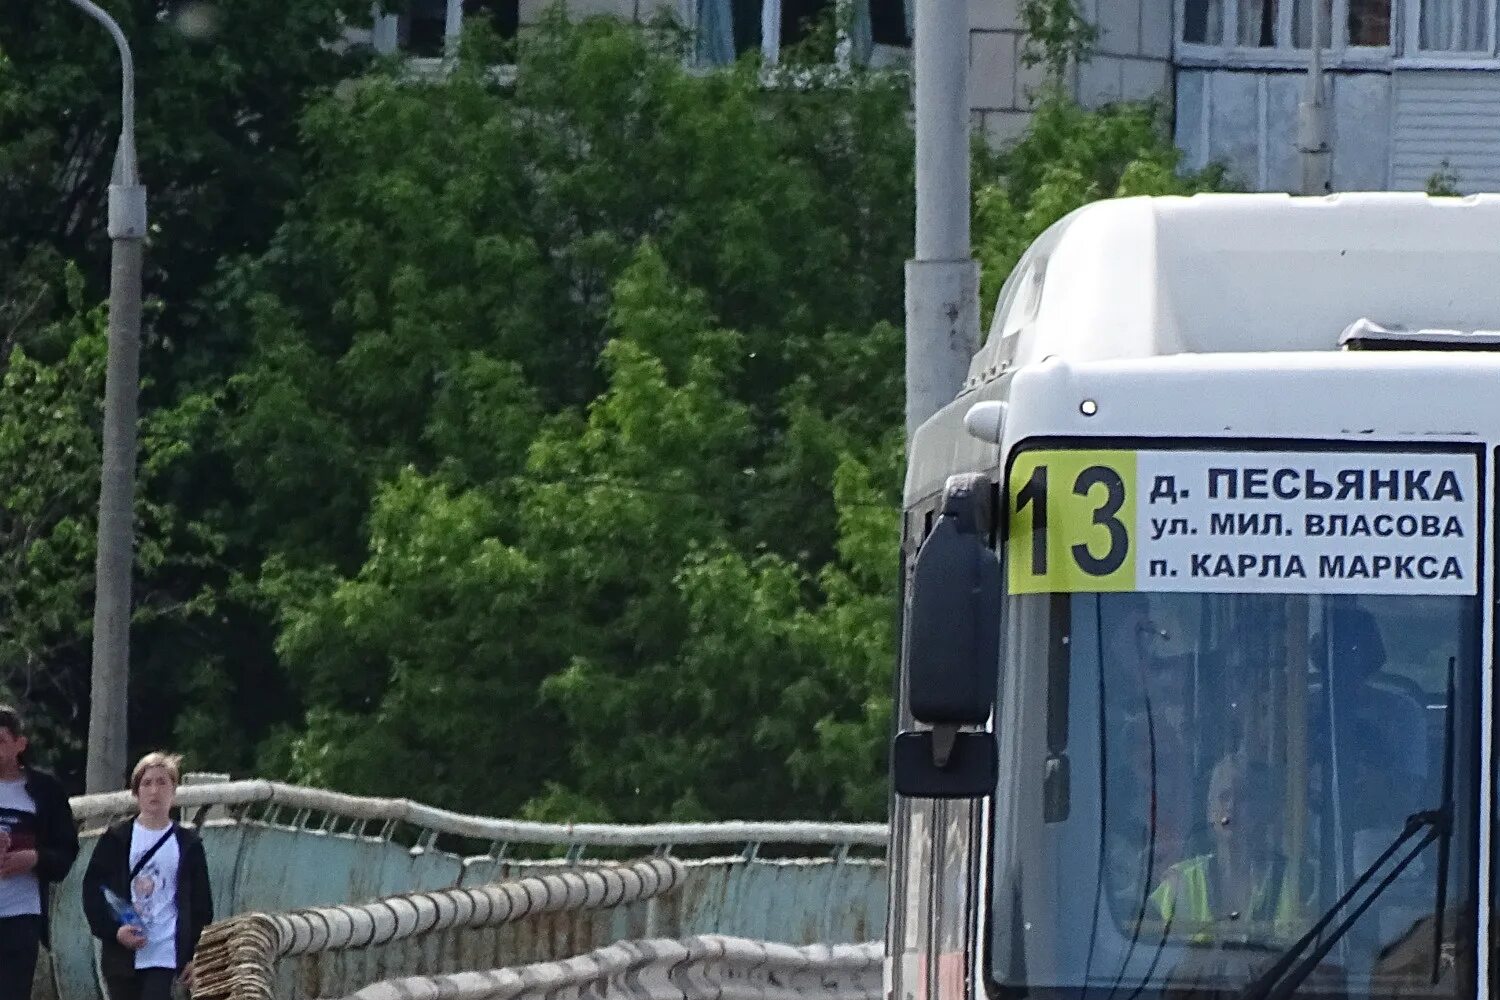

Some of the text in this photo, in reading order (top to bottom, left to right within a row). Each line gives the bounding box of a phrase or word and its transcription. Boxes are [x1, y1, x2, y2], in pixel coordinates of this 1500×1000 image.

[1150, 467, 1463, 504] д. ПЕСЬЯНКА
[1015, 465, 1130, 577] 13
[1150, 513, 1464, 541] ул. МИЛ. ВЛАСОВА
[1149, 554, 1464, 580] п. КАРЛА МАРКСА
